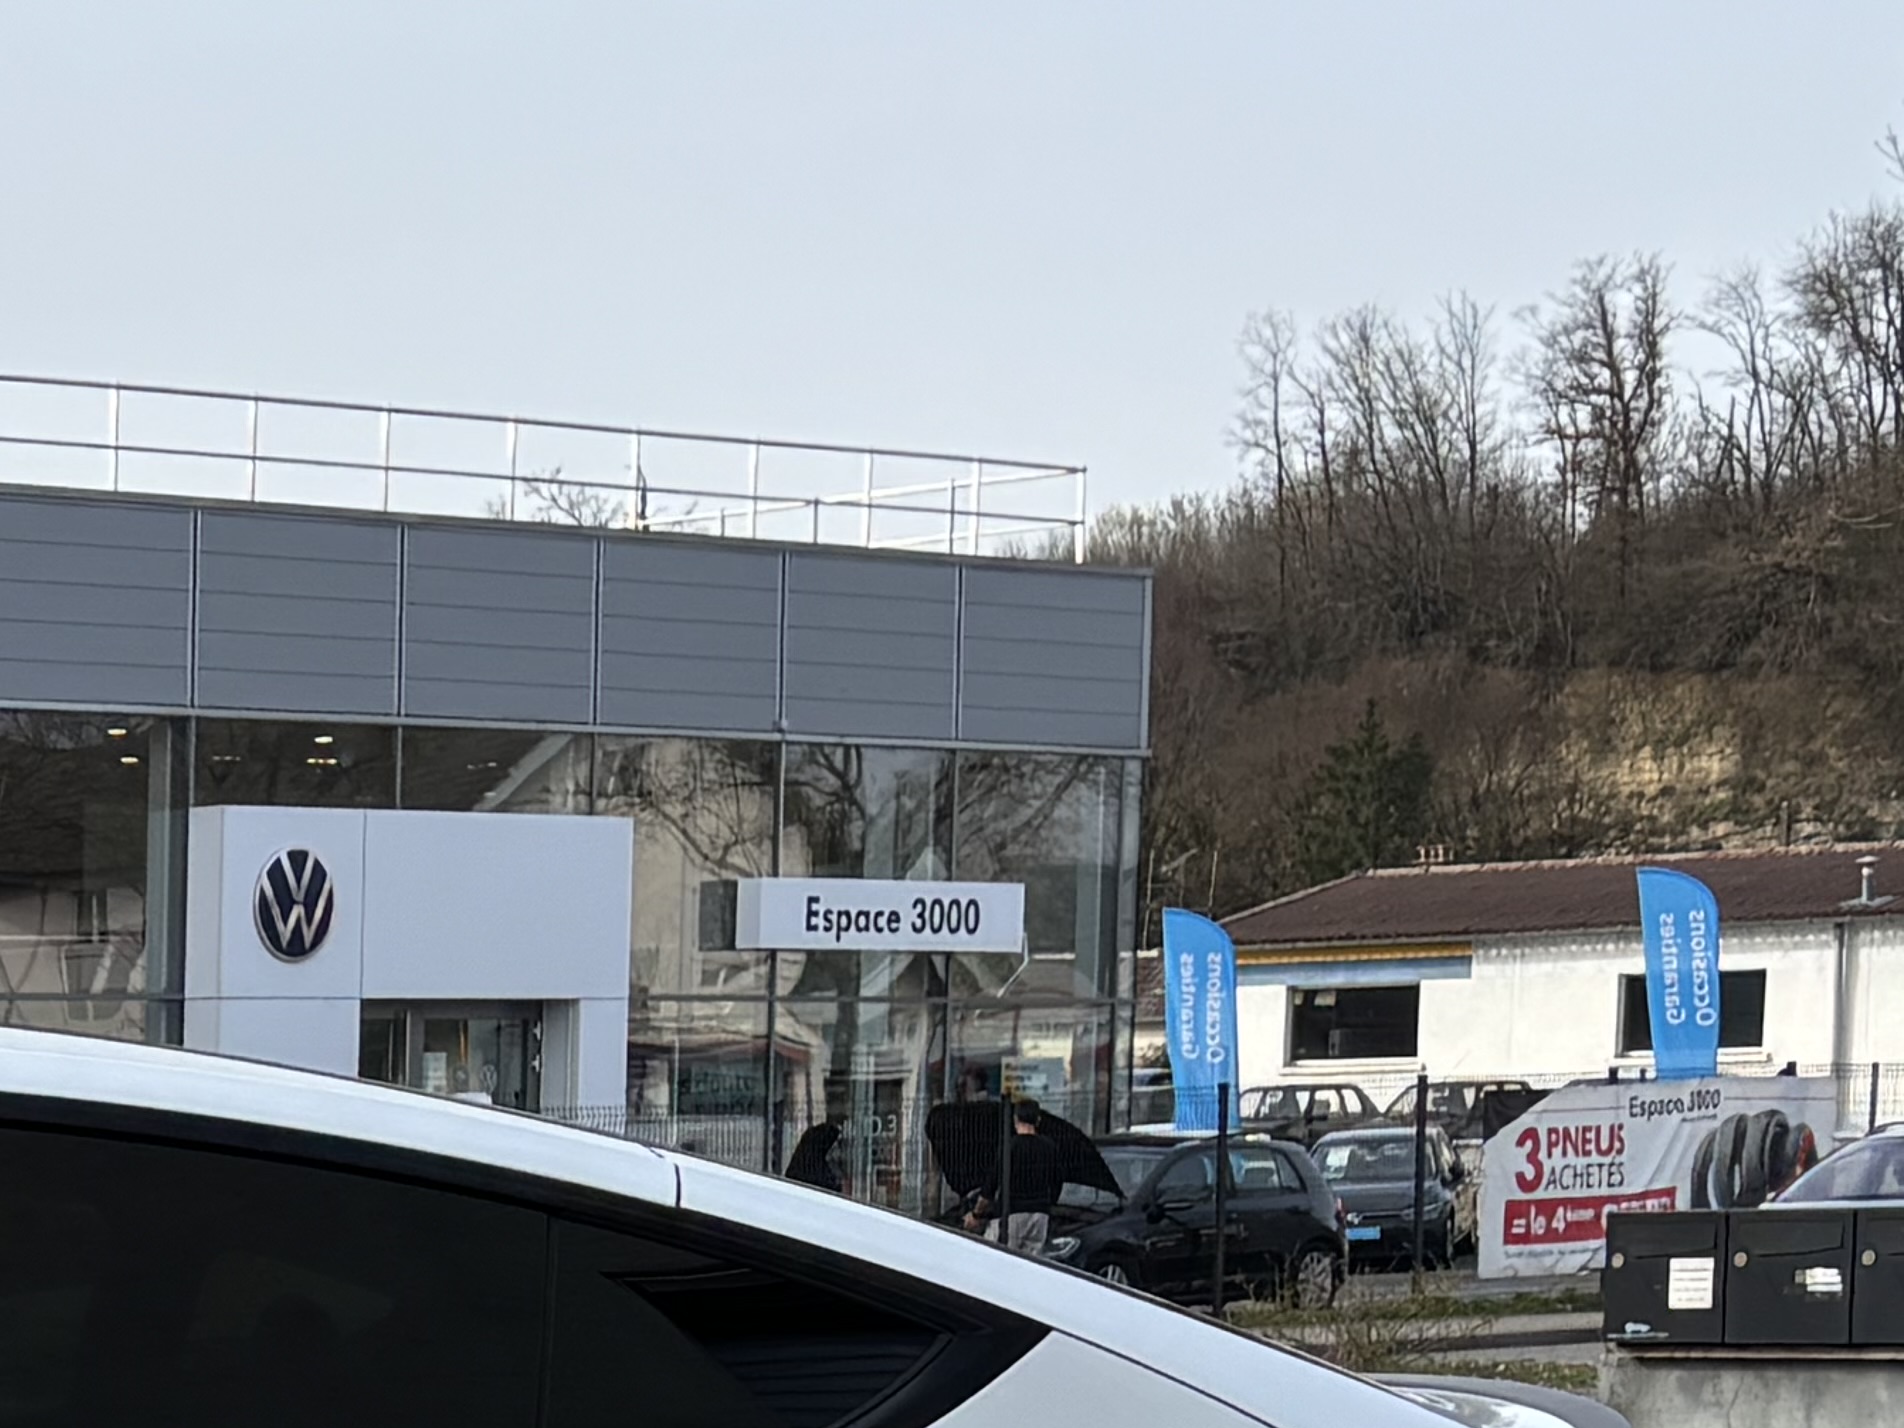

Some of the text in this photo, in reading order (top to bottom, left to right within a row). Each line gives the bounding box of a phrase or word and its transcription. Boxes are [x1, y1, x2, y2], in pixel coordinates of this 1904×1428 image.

[805, 895, 981, 941] Espace 3000
[1515, 1123, 1626, 1194] 3 PNEUS
[1544, 1155, 1626, 1192] ACHETÉS
